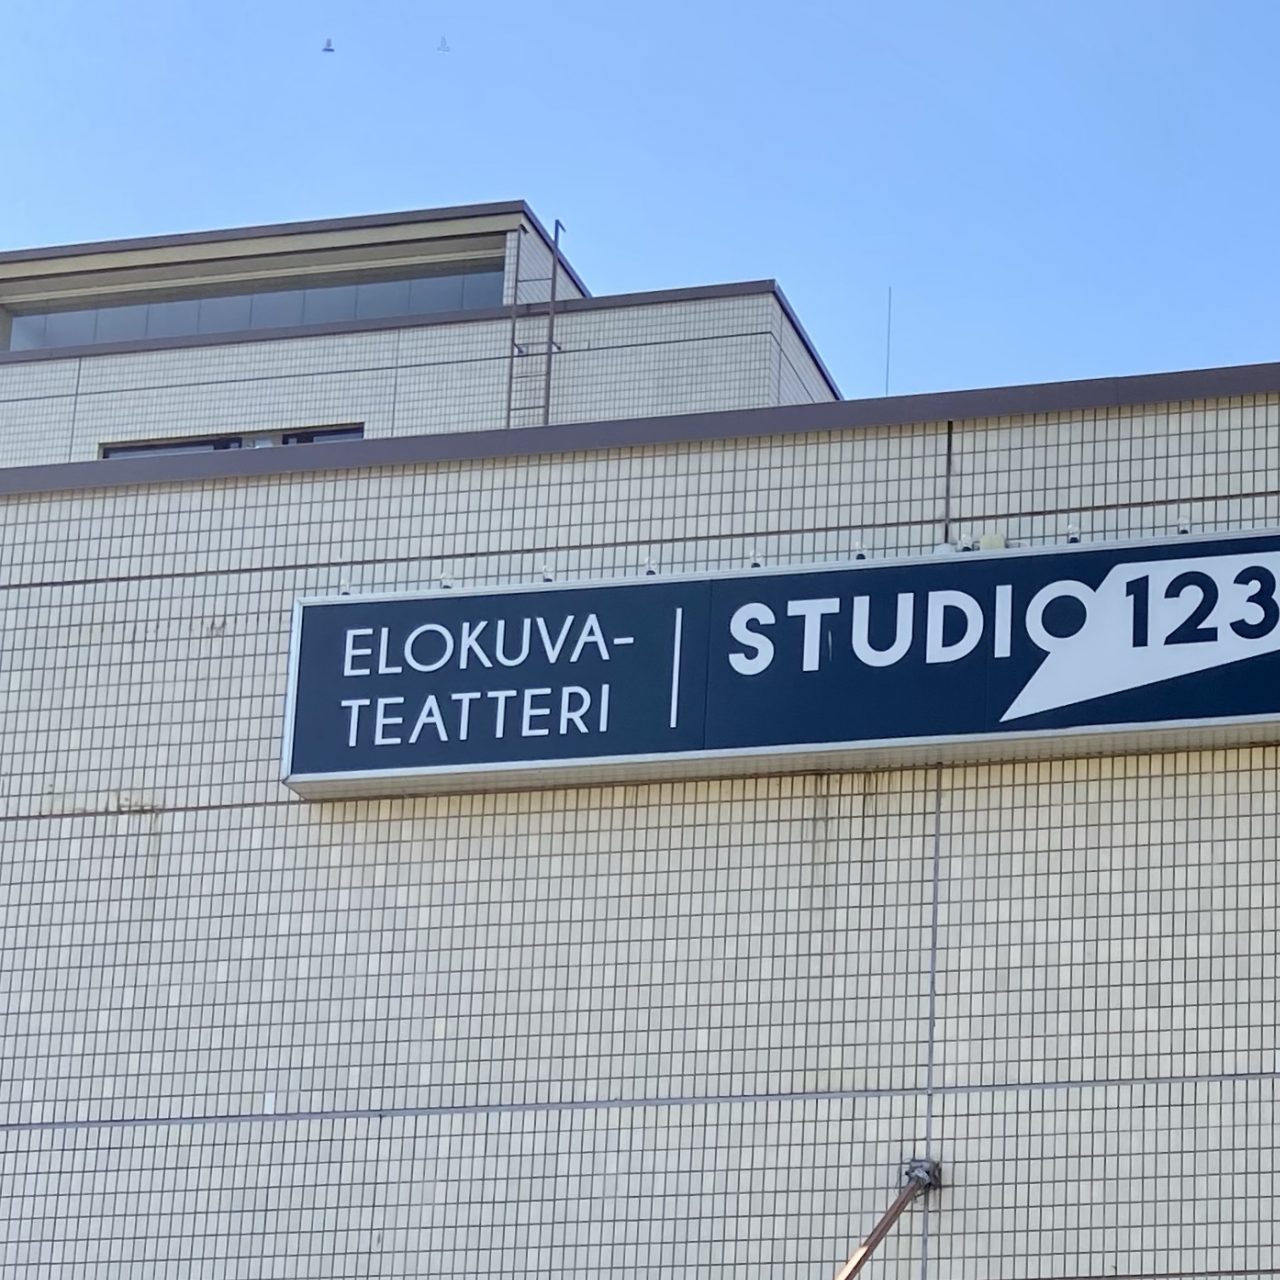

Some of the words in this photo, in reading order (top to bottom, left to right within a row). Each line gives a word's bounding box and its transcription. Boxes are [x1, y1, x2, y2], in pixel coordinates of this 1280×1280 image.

[341, 614, 635, 677] ELOKUVA-
[728, 578, 1090, 676] STUDIO
[340, 683, 610, 747] TEATTERI
